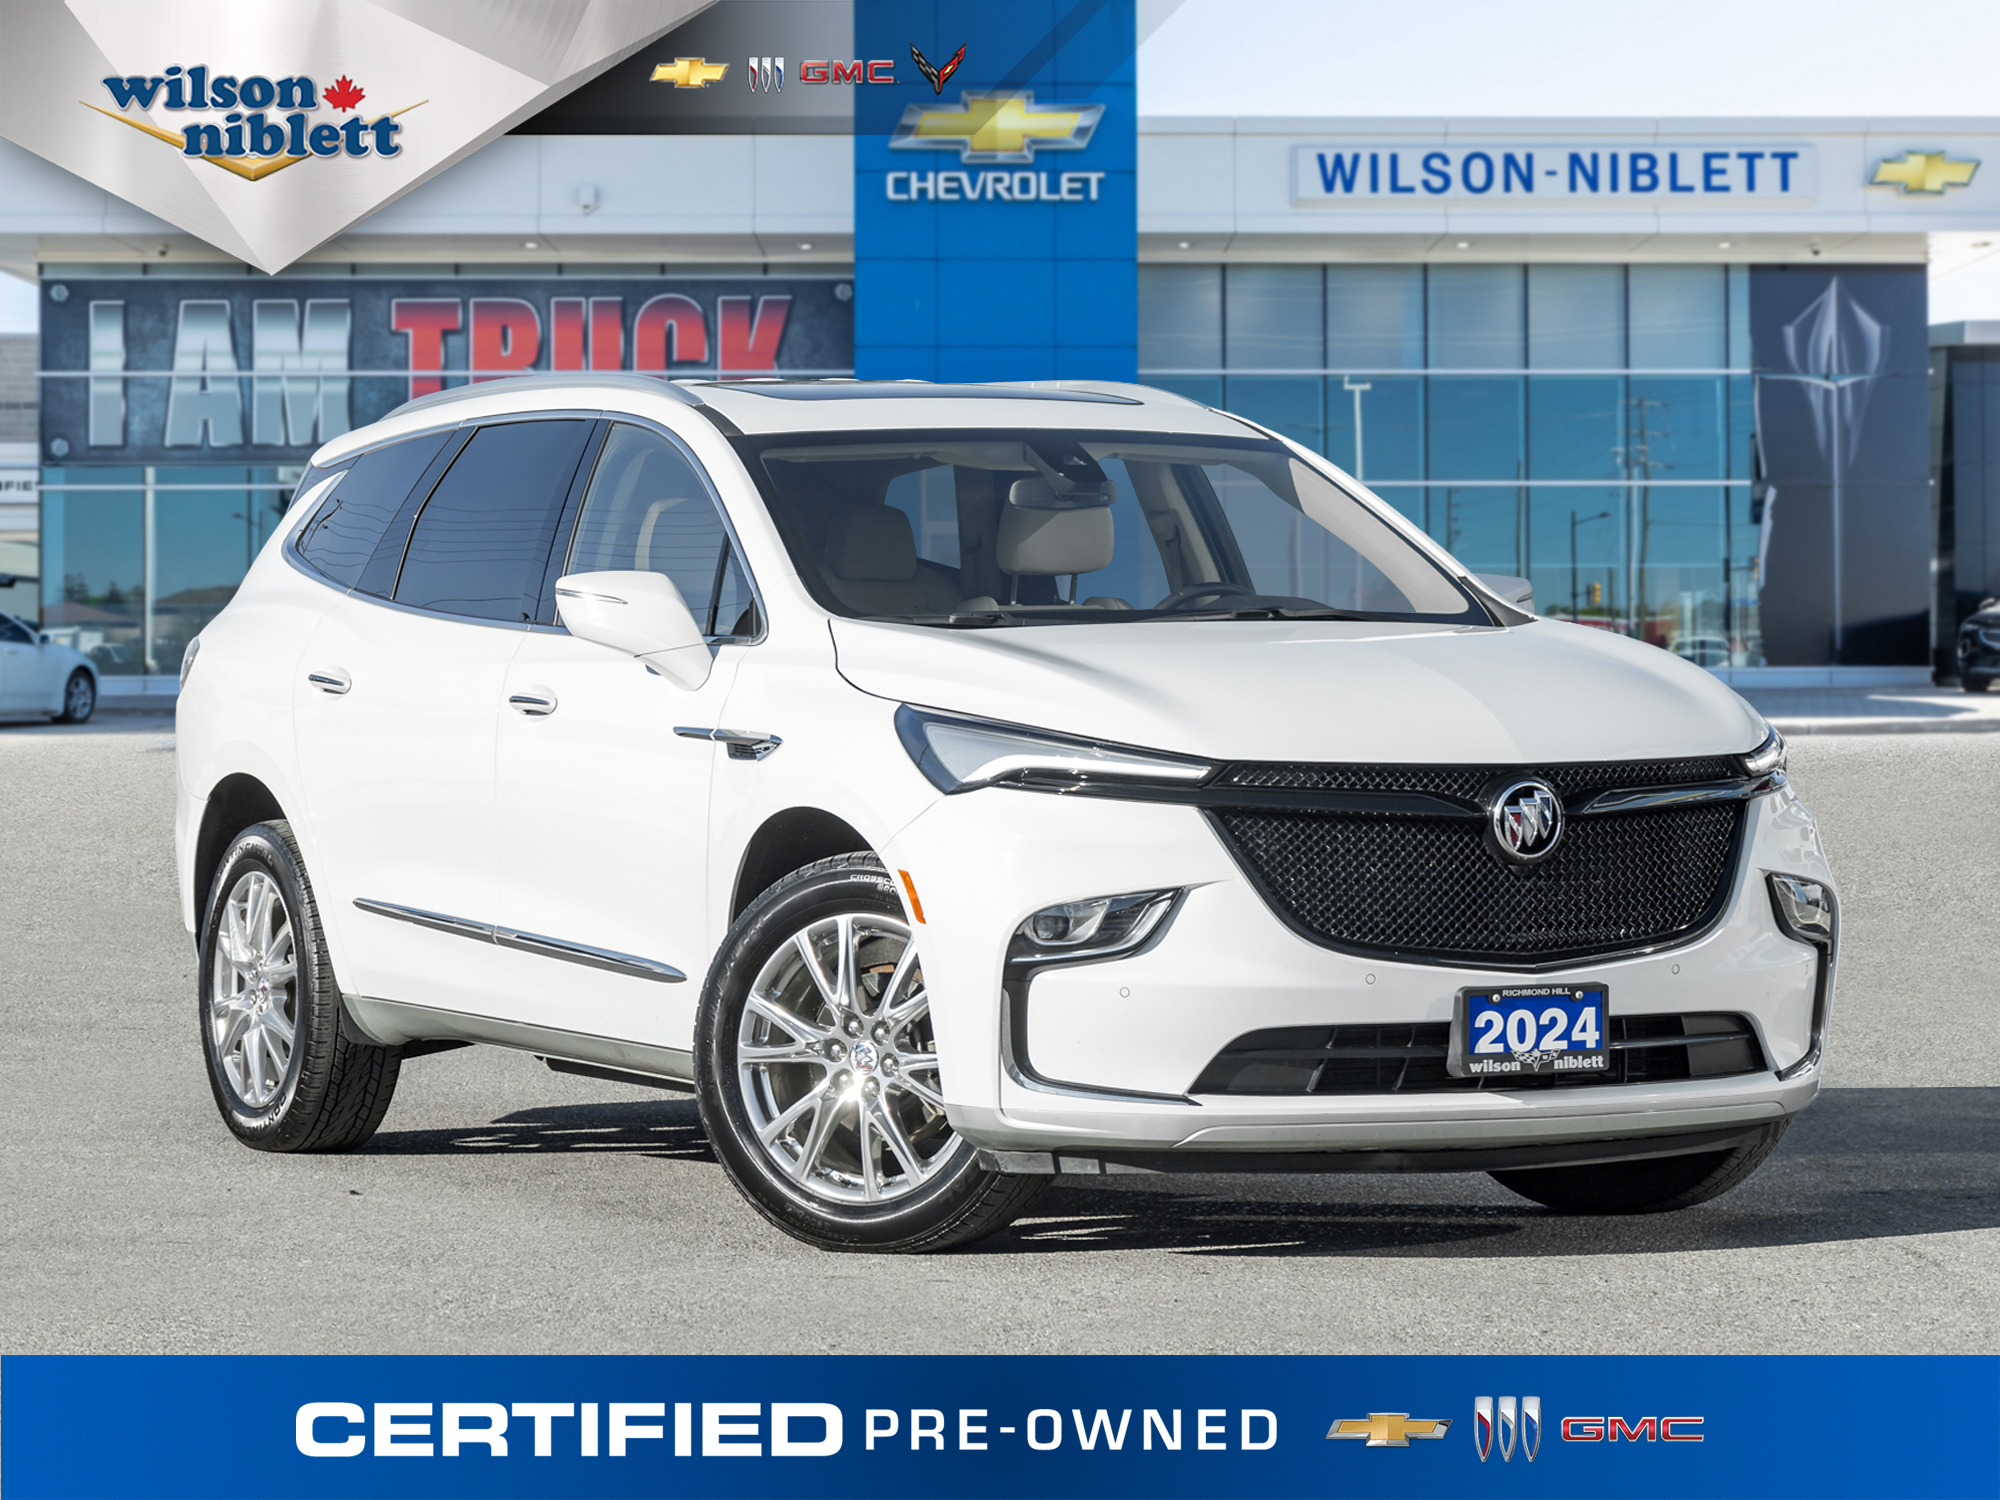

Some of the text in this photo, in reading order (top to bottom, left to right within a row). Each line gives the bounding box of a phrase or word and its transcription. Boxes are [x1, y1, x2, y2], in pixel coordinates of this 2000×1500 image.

[886, 171, 1105, 202] CHEVROLET
[1317, 151, 1800, 194] WILSON-NIBLETT
[88, 299, 127, 448] I
[164, 299, 352, 448] AM
[1502, 987, 1571, 997] RICHMOND HILL
[1474, 1006, 1600, 1054] 2024
[1469, 1059, 1521, 1073] wilson
[1553, 1055, 1604, 1070] niblett
